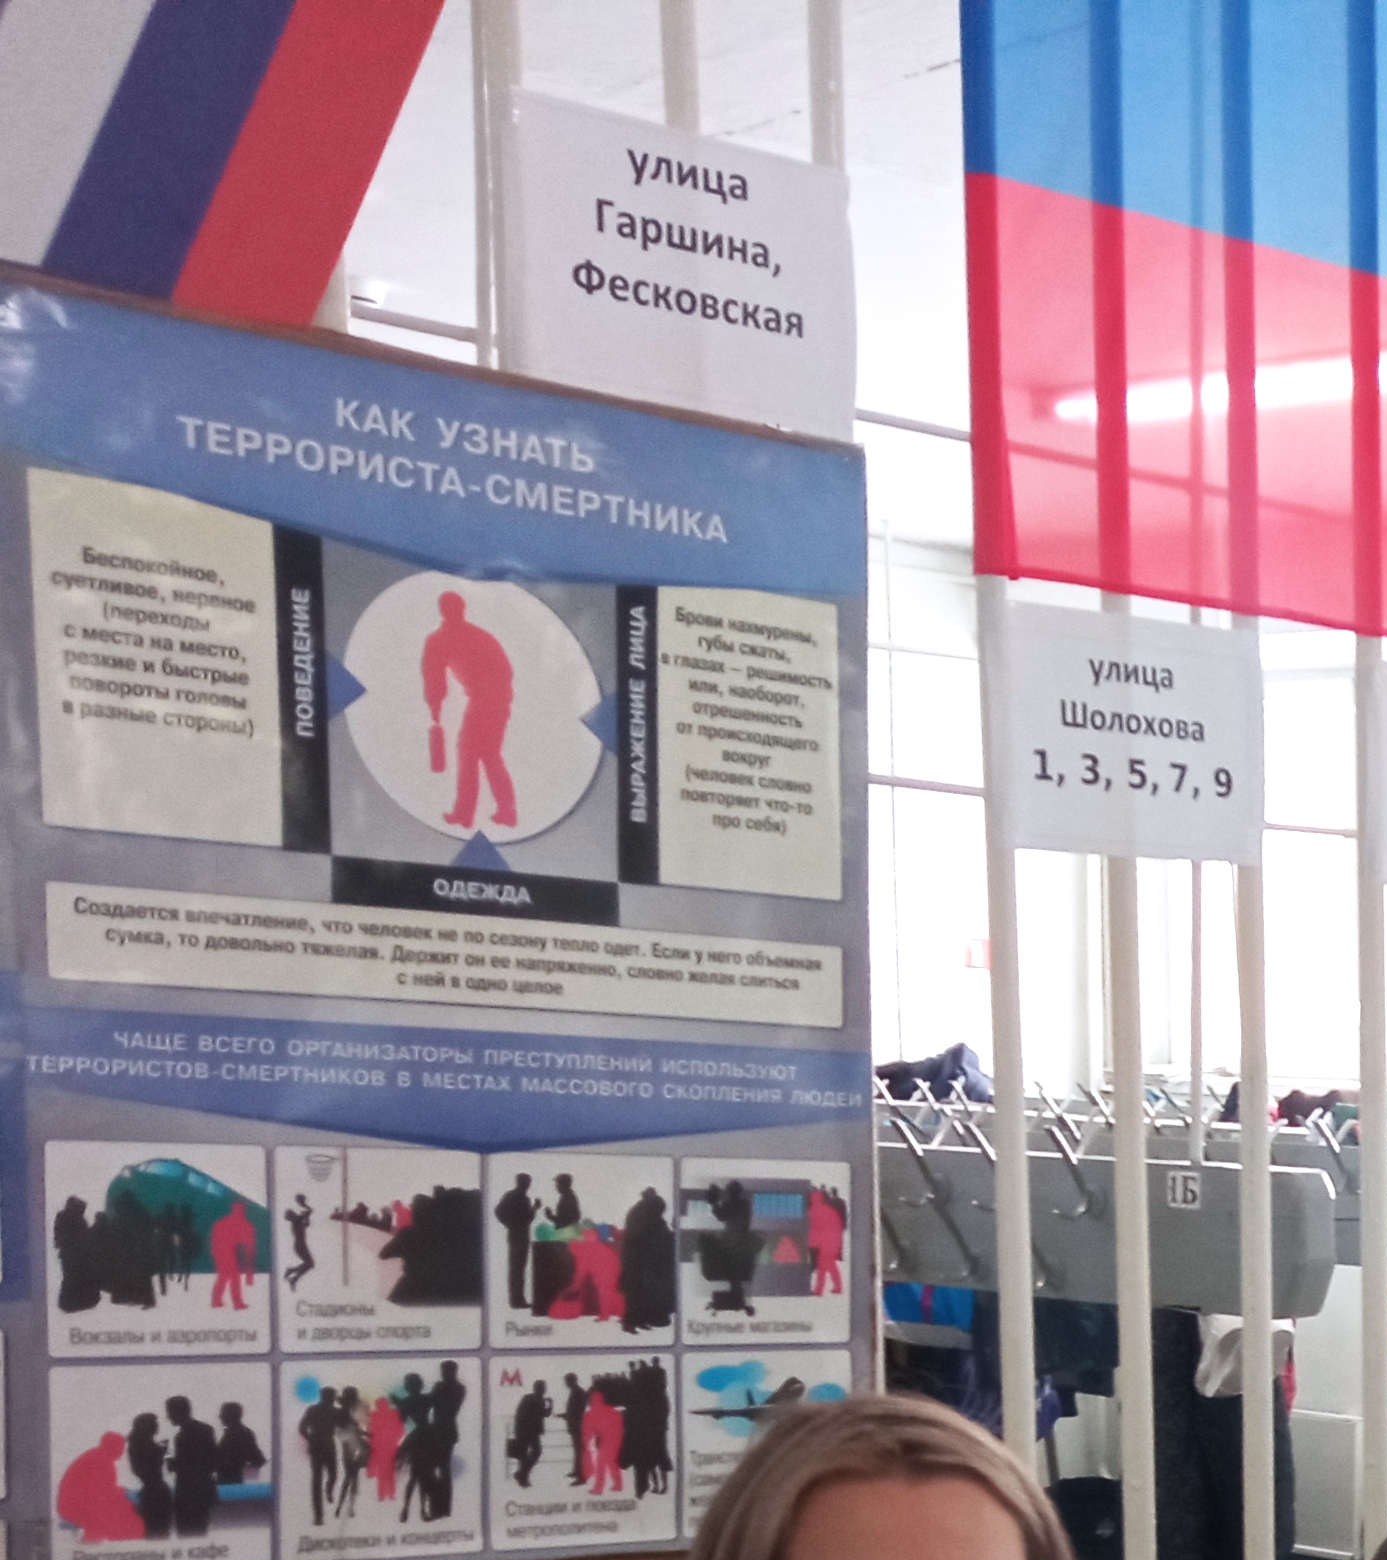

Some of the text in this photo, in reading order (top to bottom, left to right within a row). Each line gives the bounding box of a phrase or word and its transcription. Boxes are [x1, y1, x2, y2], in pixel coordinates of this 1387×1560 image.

[627, 149, 748, 204] улица
[596, 198, 781, 277] Гаршина,
[573, 259, 804, 338] Фесковская
[336, 398, 594, 473] КАК УЗНАТЬ
[175, 415, 728, 543] ТЕРРОРИСТА-СМЕРТНИКА
[82, 545, 225, 586] Беспокойное,
[63, 624, 246, 664] с места на место,
[64, 649, 249, 685] резкие и быстрые
[291, 588, 315, 738] ПОВЕДЕНИЕ
[69, 675, 247, 709] повороты головы
[1089, 658, 1174, 693] улица
[80, 702, 156, 724] разные
[163, 711, 254, 738] стороны)
[629, 605, 647, 823] ВЫРАЖЕНИЕ ЛИЦА
[1060, 699, 1205, 743] Шолохова
[1033, 748, 1233, 800] 1, 3, 5, 7, 9
[432, 878, 533, 905] ОДЕЖДА
[73, 896, 179, 922] Создается
[185, 910, 315, 935] впечатление,
[322, 921, 353, 935] что
[358, 923, 432, 941] человек
[437, 928, 458, 942] не
[464, 931, 484, 945] по
[489, 933, 547, 953] сезону
[553, 937, 599, 954] тепло
[604, 941, 645, 959] одет.
[652, 942, 689, 961] Если
[707, 950, 742, 965] него
[745, 949, 822, 971] объемная
[396, 971, 564, 996] с ней в одно целое
[113, 1031, 798, 1081] ЧАЩЕ ВСЕГО ОРГАНИЗАТОРЫ ПРЕСТУПЛЕНИЙ ИСПОЛЬЗУЮТ
[396, 1071, 410, 1087] В
[421, 1071, 511, 1091] МЕСТАХ
[521, 1076, 654, 1098] МАССОВОГО
[663, 1082, 783, 1103] СКОПЛЕНИЯ
